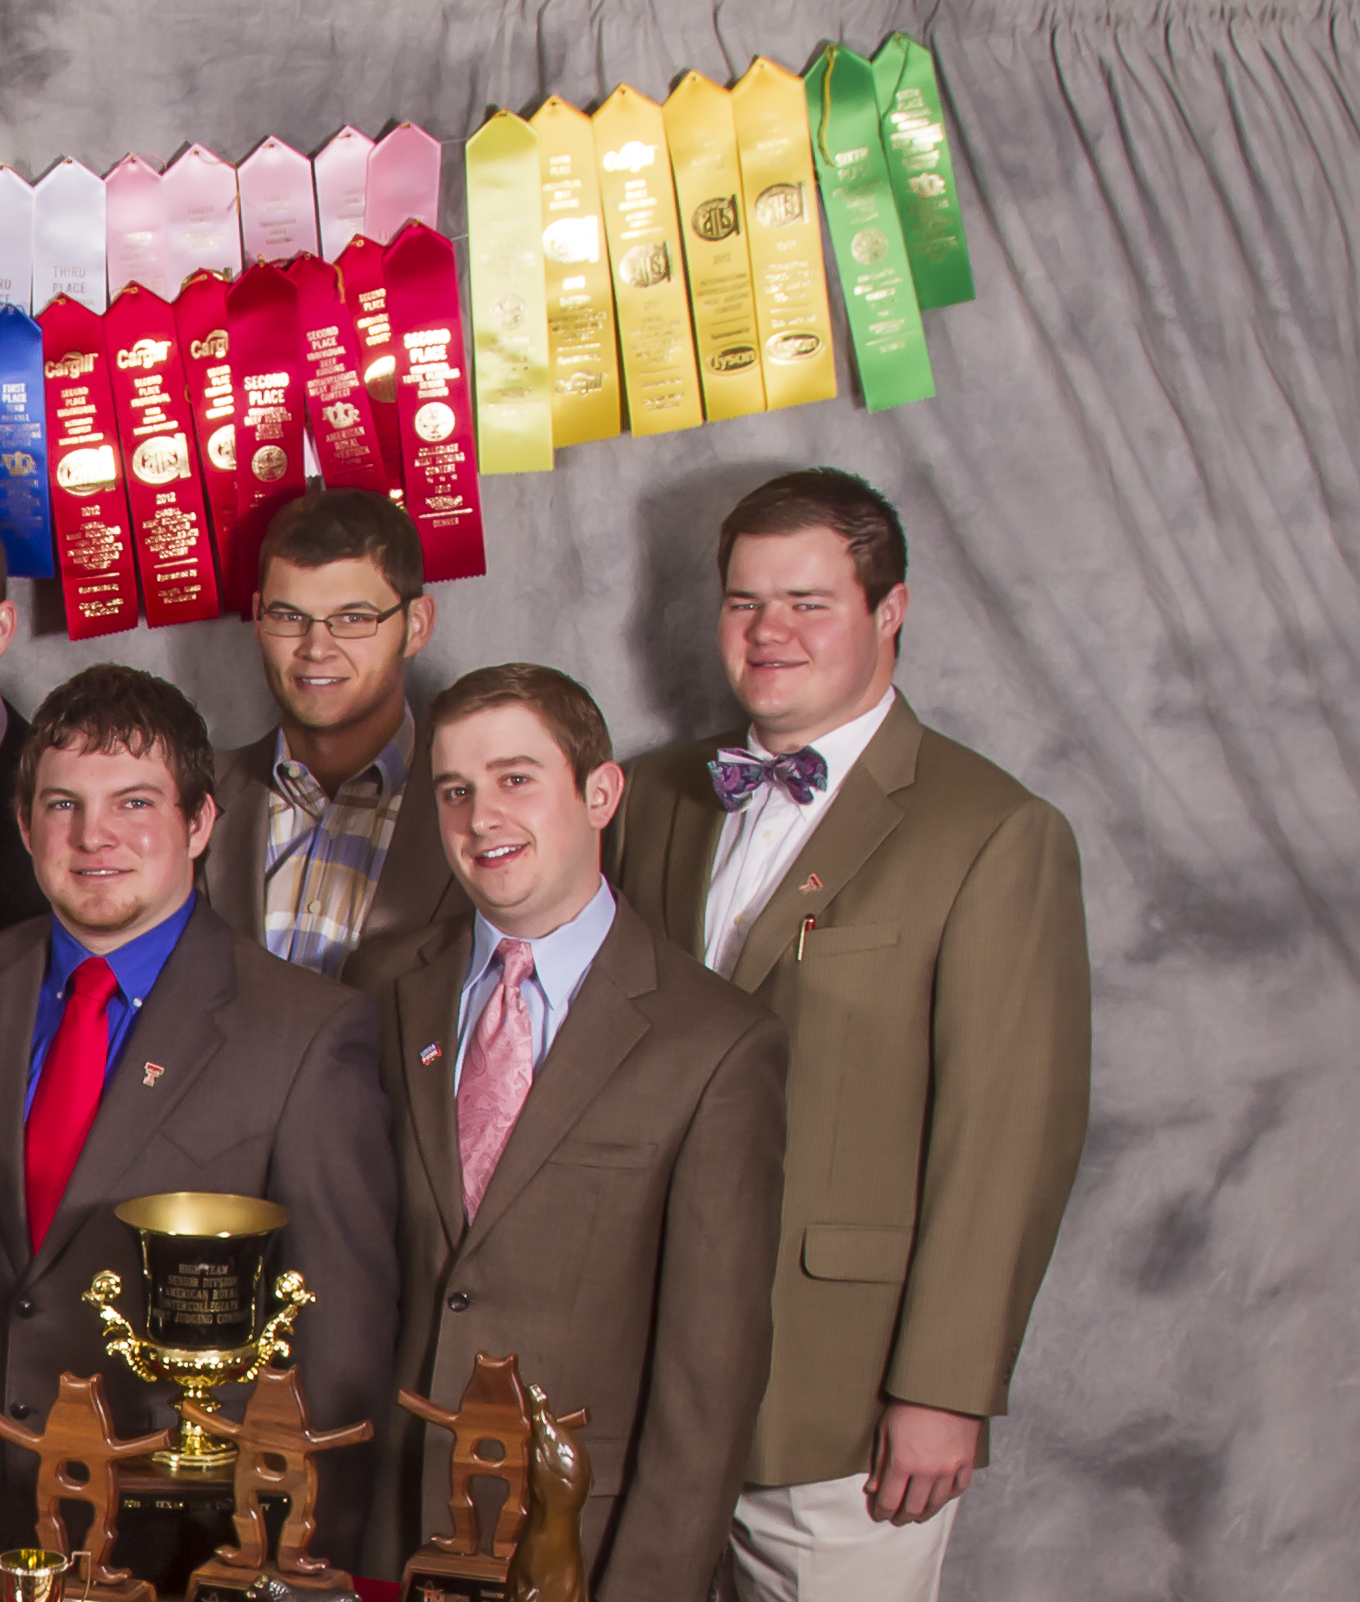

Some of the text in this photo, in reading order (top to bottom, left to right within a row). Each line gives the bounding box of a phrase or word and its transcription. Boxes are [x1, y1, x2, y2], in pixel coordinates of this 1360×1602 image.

[403, 329, 451, 347] SECOND
[117, 339, 171, 367] Cargill
[410, 346, 448, 361] PLACE
[45, 353, 98, 378] Cargill
[244, 372, 289, 388] SECOND
[249, 389, 285, 404] PLACE
